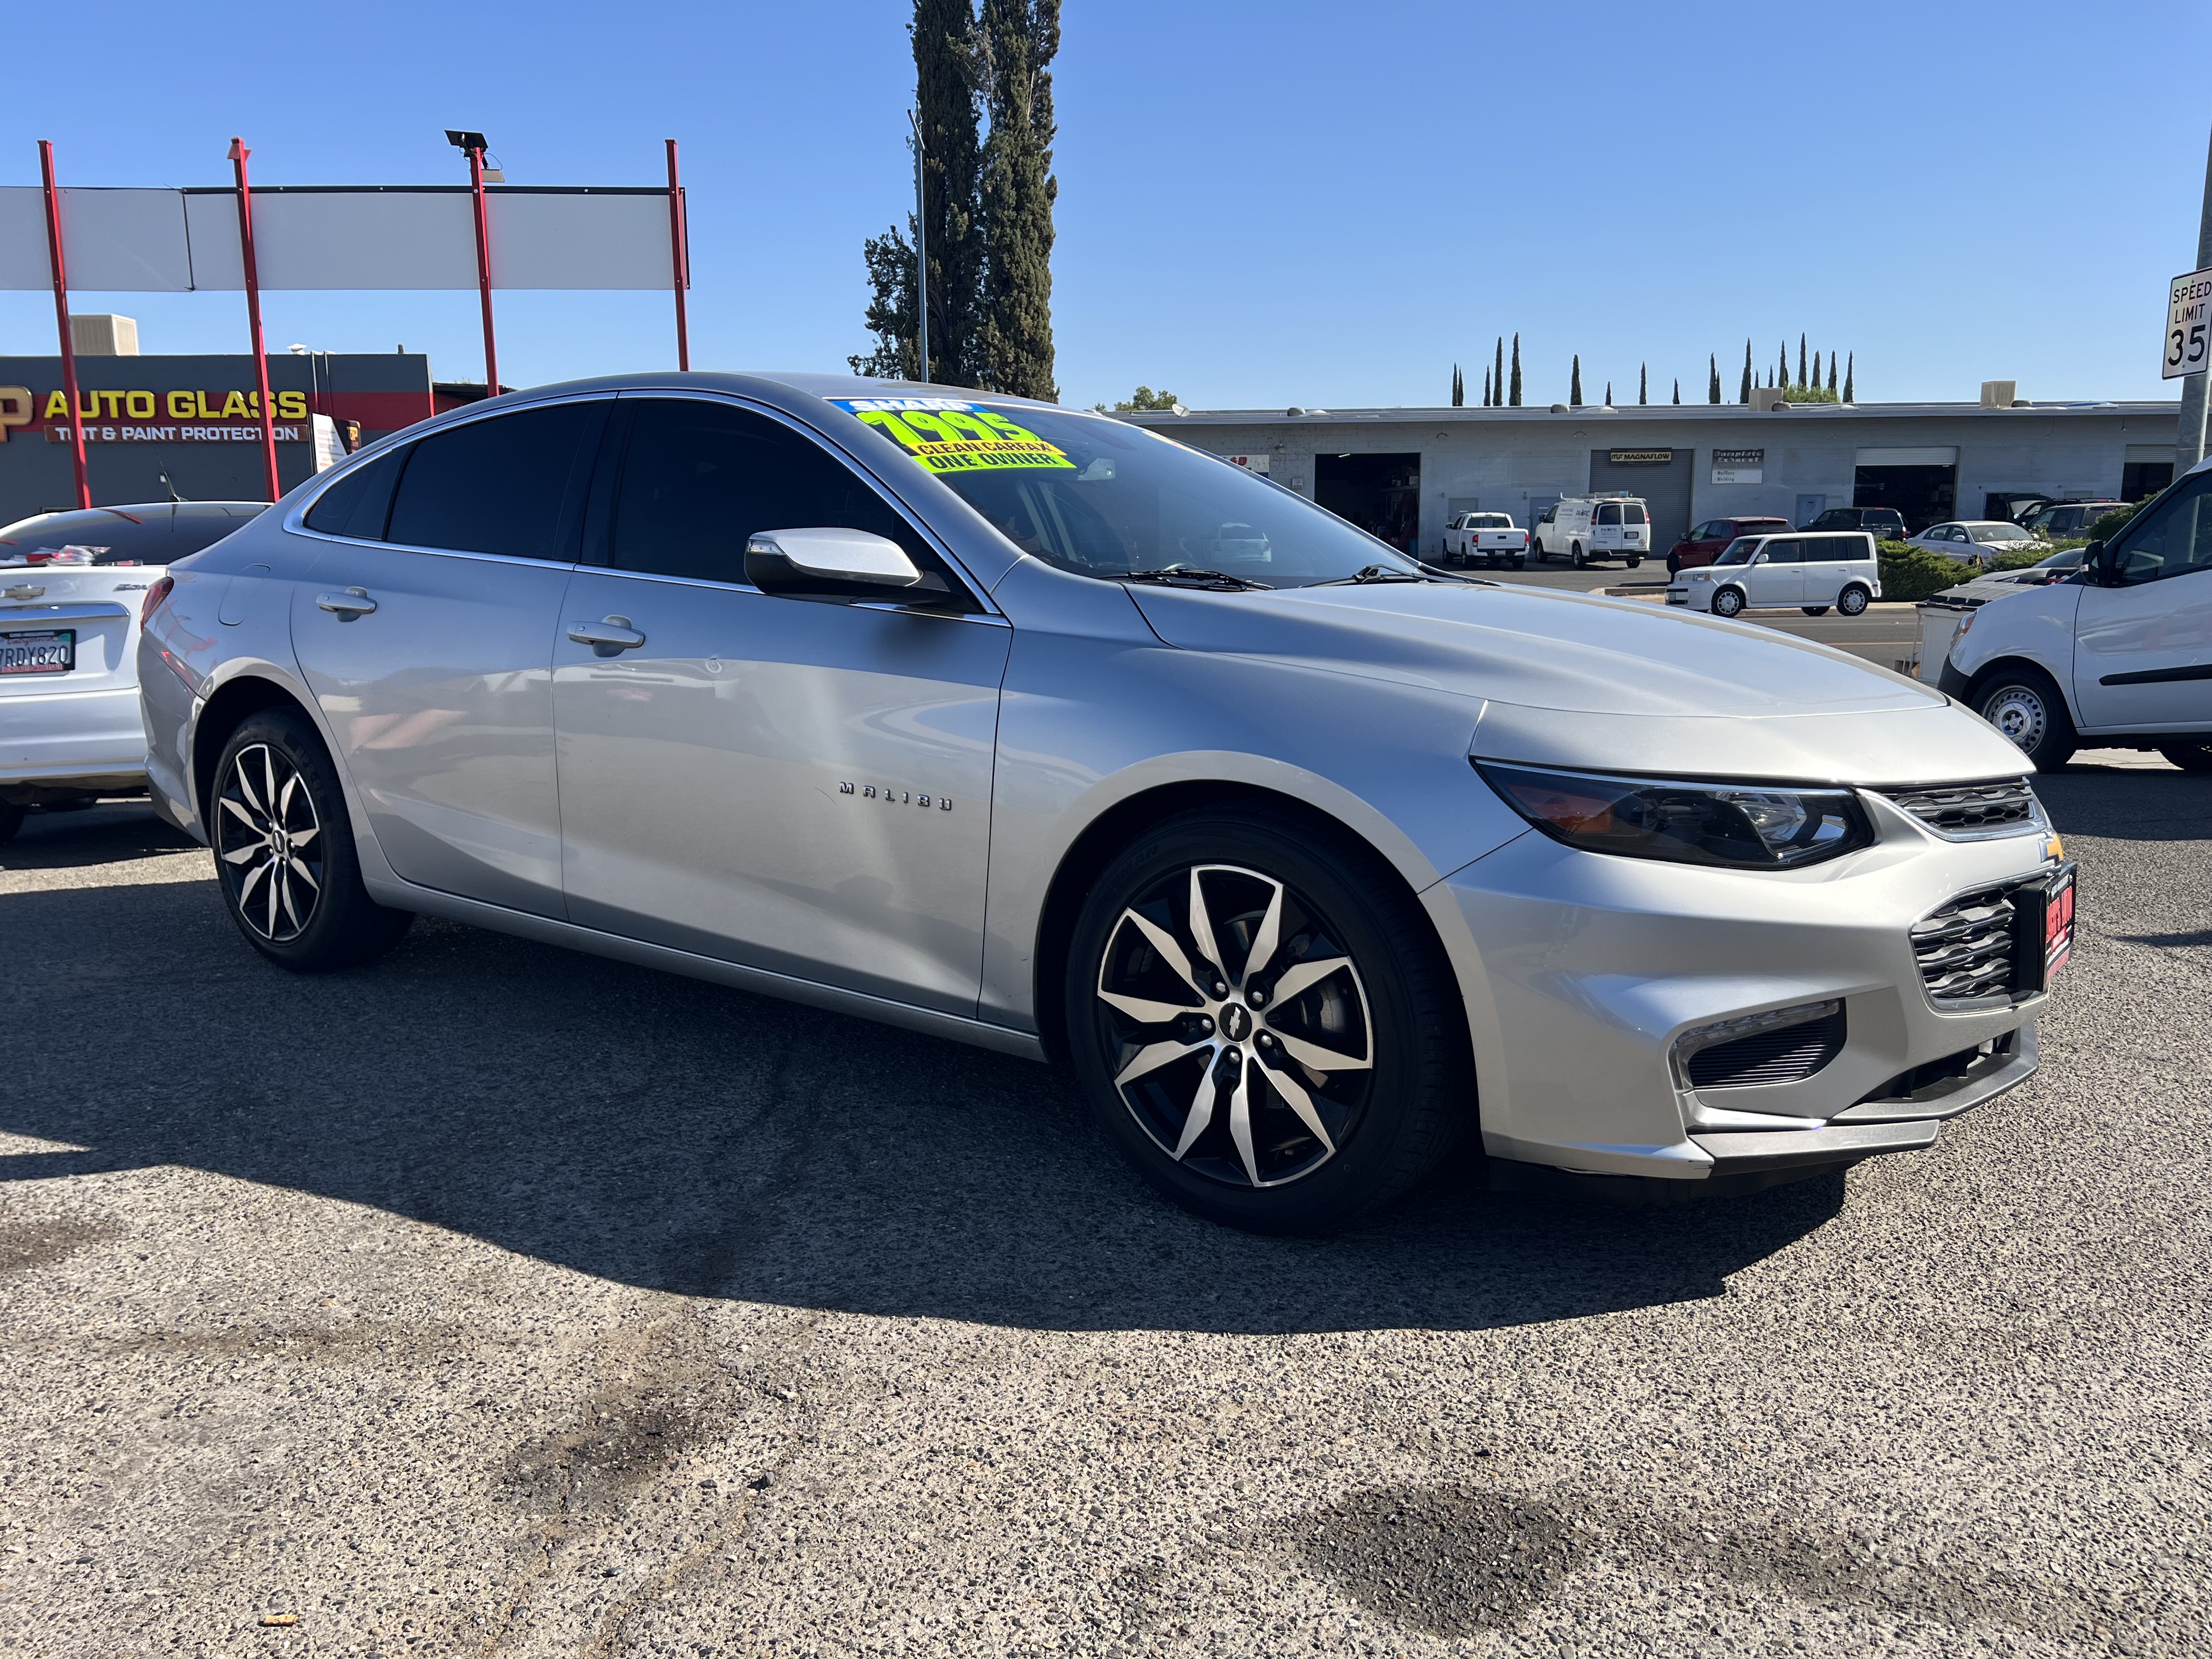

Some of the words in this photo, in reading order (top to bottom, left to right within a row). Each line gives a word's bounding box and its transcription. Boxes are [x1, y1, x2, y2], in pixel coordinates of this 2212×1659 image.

[2173, 281, 2211, 303] SPEED
[2175, 303, 2205, 324] LIMIT
[2168, 324, 2206, 366] 35
[44, 390, 155, 419] AUTO
[167, 390, 307, 419] GLASS
[849, 399, 973, 411] SHARP
[102, 427, 116, 440] &
[121, 427, 176, 440] PAINT
[181, 427, 298, 440] PROTECTON
[856, 410, 1041, 444] 7995
[917, 442, 981, 455] CLEAN
[981, 441, 1054, 453] CARFAX
[926, 454, 979, 469] ONE
[978, 453, 1060, 466] OWNER
[839, 781, 952, 810] MALIBU
